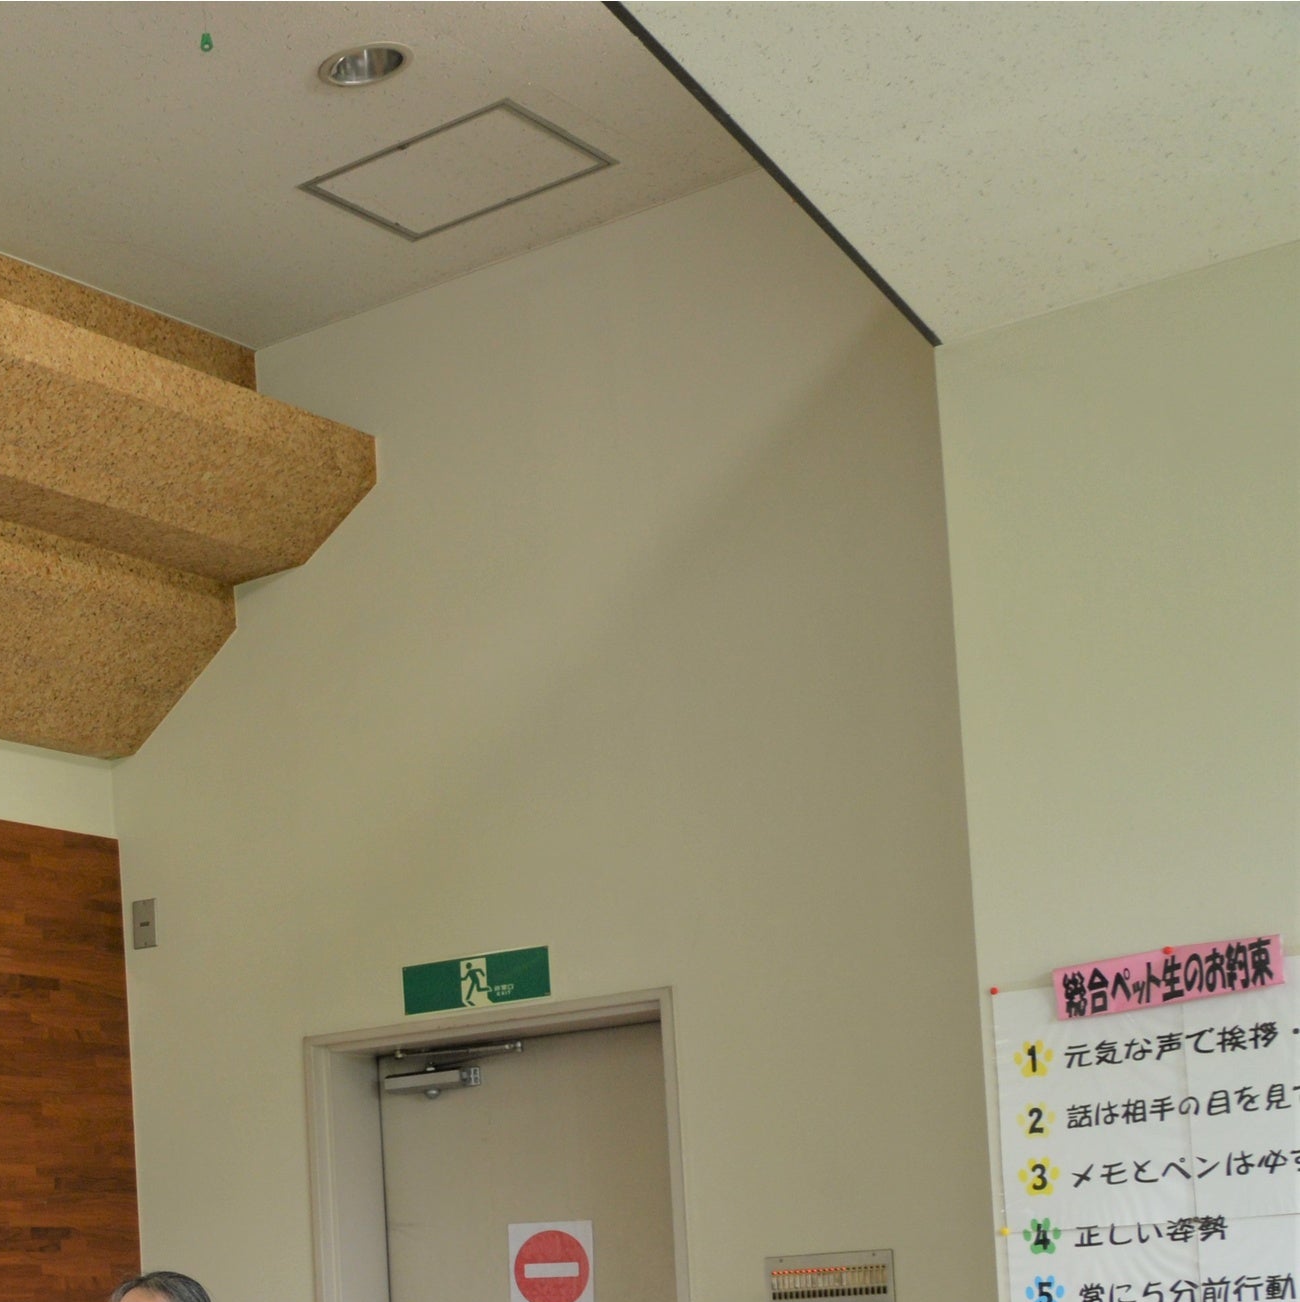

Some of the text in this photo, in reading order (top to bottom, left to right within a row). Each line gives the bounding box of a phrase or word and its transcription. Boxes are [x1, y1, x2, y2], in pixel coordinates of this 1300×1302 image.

[1063, 937, 1274, 1018] 総合ペット生のお約束
[1027, 1045, 1039, 1073] 1
[1028, 1107, 1045, 1134] 2
[1031, 1163, 1048, 1191] 3
[1034, 1214, 1228, 1250] 4 正しい姿勢
